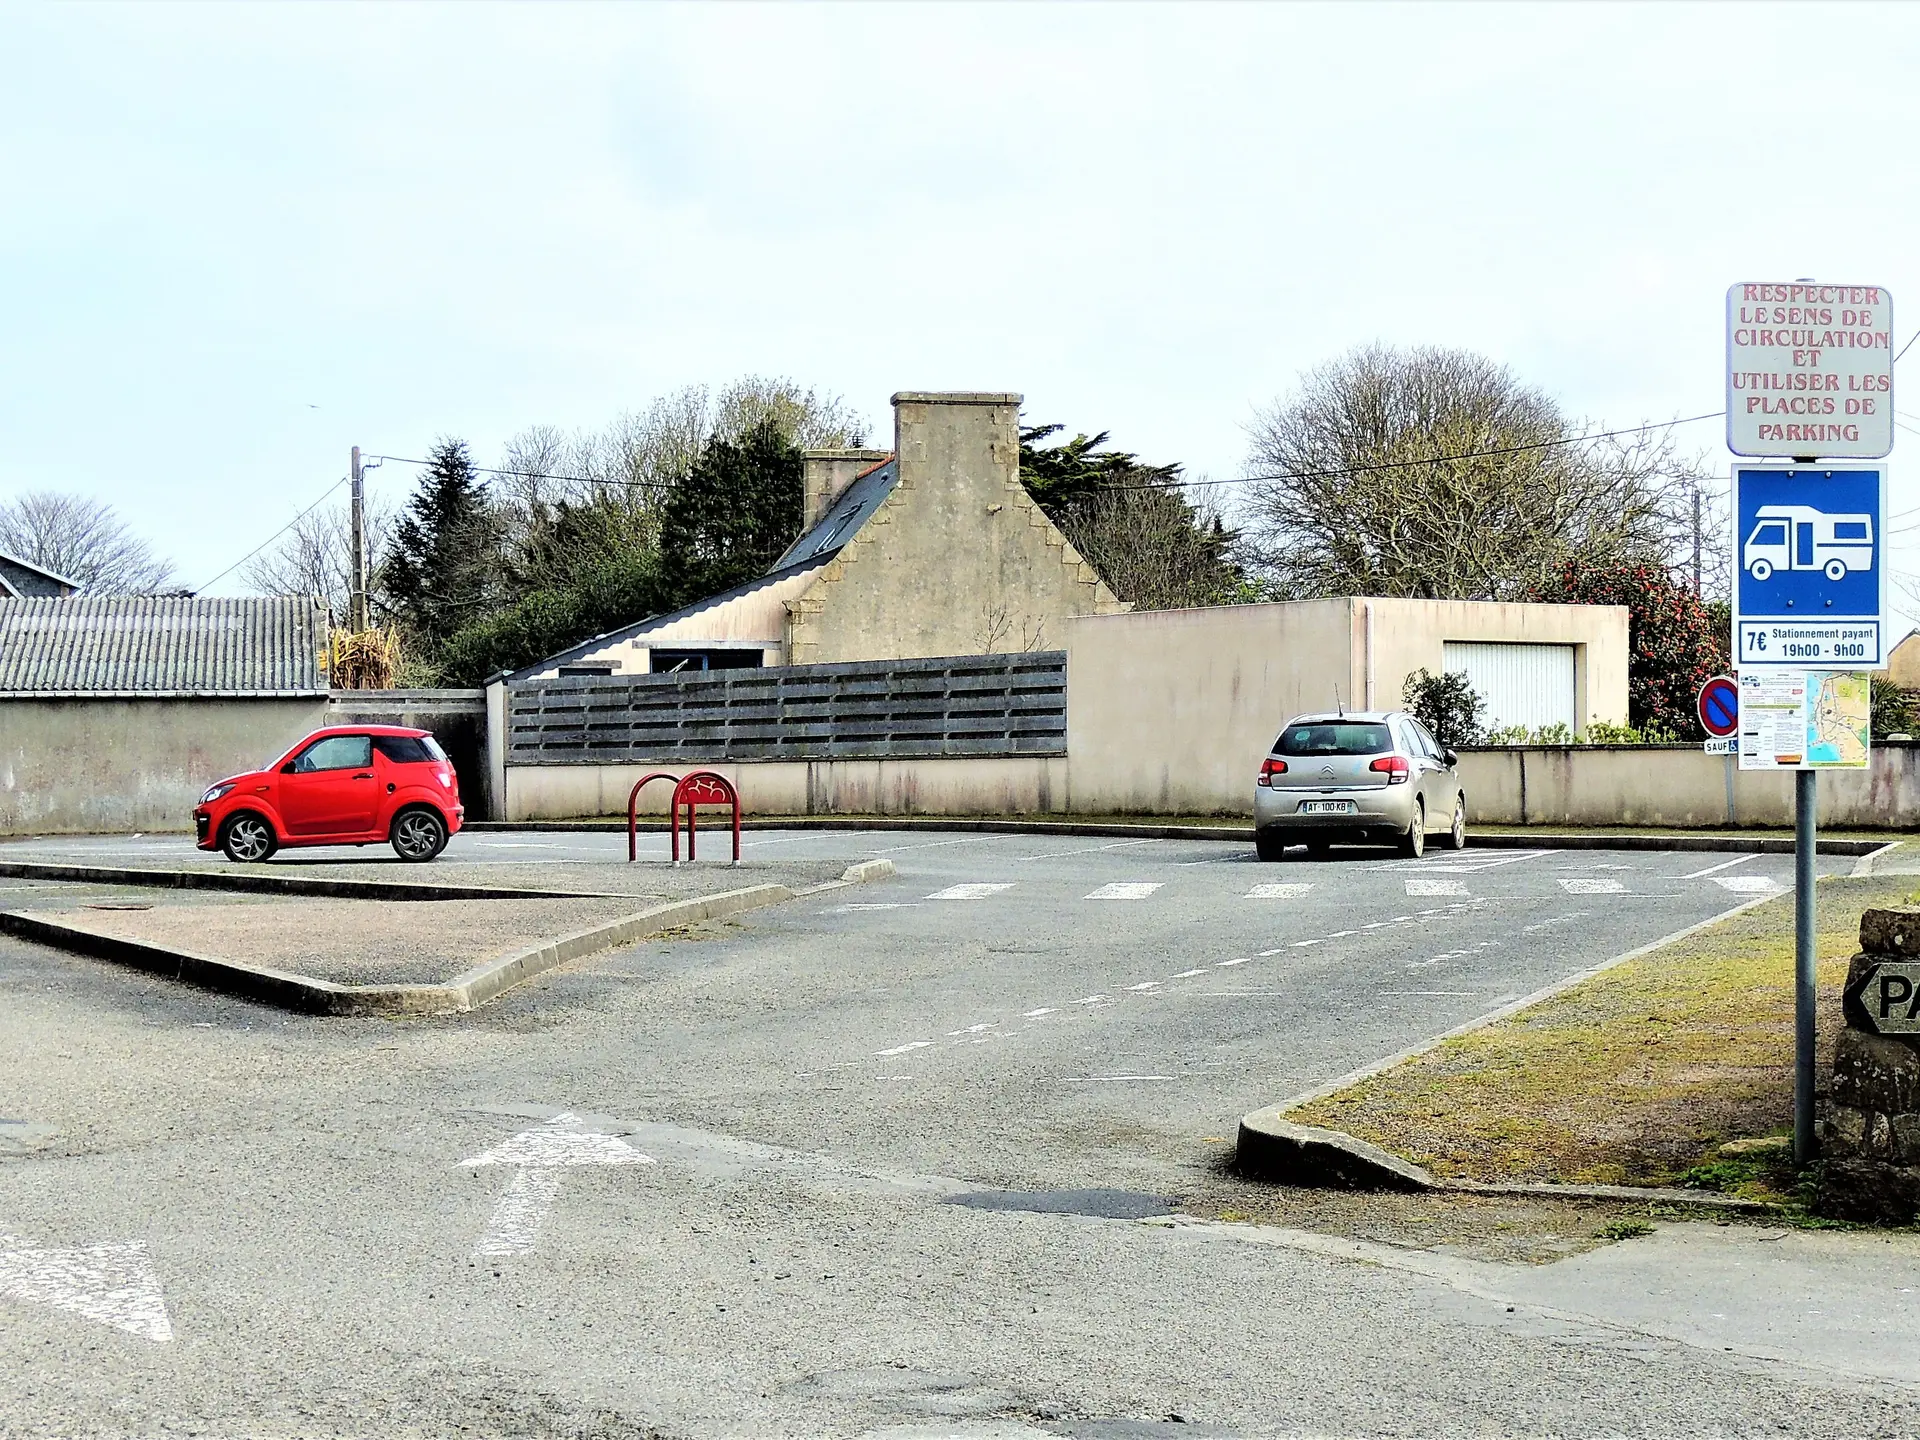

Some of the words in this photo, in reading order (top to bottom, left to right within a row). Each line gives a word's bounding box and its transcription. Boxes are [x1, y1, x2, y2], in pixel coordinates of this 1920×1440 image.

[1743, 284, 1880, 305] RESPECTER
[1740, 307, 1768, 324] LE
[1772, 307, 1833, 326] SENS
[1842, 309, 1873, 327] DE
[1734, 329, 1889, 349] CIRCULATION
[1792, 350, 1821, 367] ET
[1732, 372, 1840, 391] UTILISER
[1848, 374, 1890, 392] LES
[1746, 396, 1835, 415] PLACES
[1844, 398, 1876, 415] DE
[1758, 423, 1859, 442] PARKING
[1747, 631, 1767, 651] 7€
[1772, 628, 1839, 639] Stationnement
[1842, 628, 1873, 641] payant
[1782, 643, 1820, 657] 19h00
[1834, 643, 1864, 657] 9h00
[1706, 742, 1727, 752] SAUF
